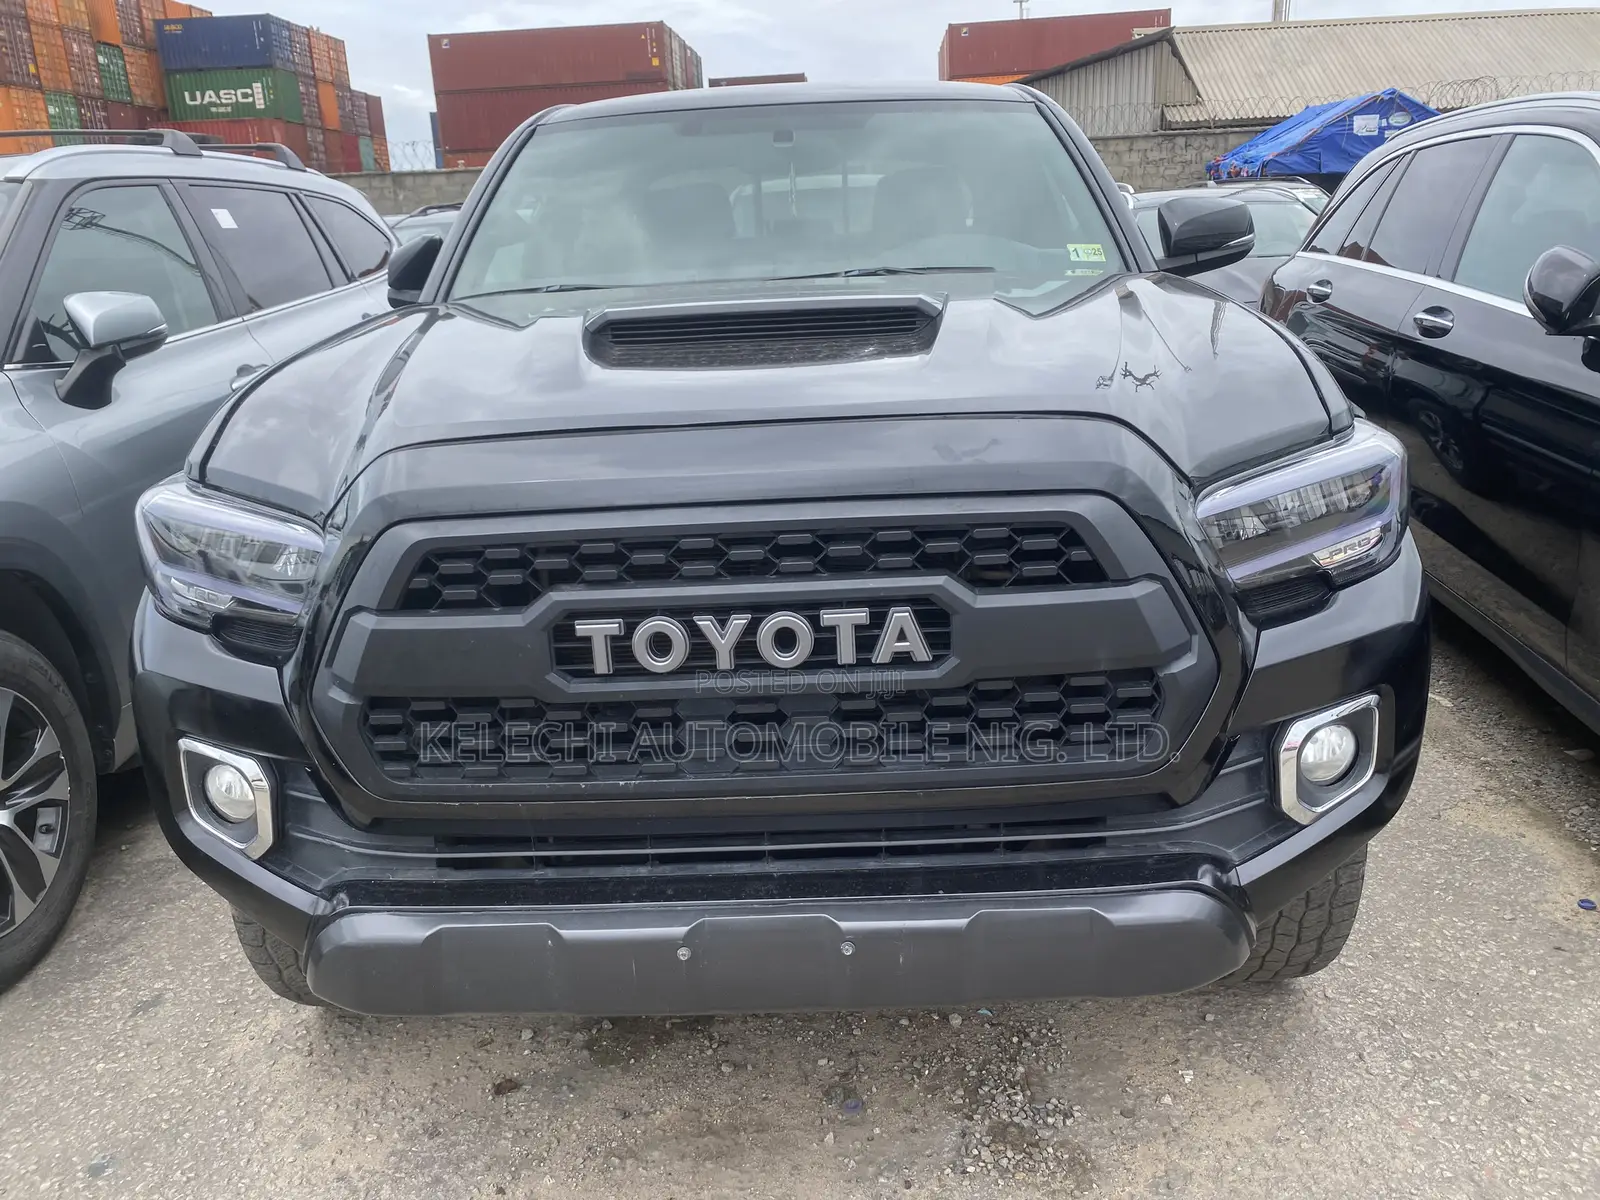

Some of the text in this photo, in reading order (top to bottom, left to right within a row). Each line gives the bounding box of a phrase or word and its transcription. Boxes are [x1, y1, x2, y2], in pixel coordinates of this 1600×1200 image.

[184, 88, 254, 105] UASC
[1328, 536, 1371, 560] PRO
[574, 606, 934, 675] TOYOTA
